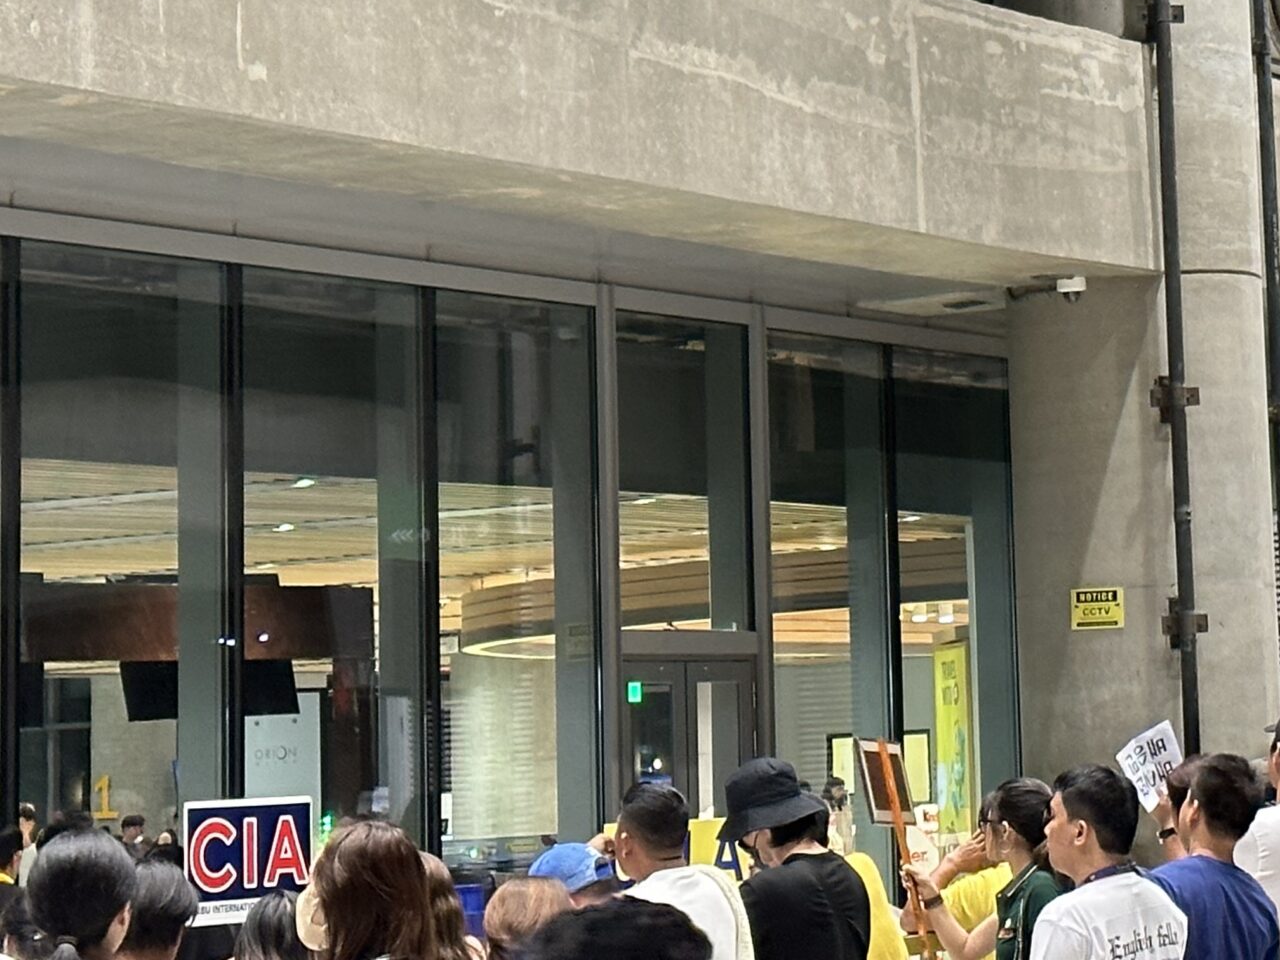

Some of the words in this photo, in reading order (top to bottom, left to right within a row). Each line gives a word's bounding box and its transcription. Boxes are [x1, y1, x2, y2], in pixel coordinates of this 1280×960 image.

[1079, 591, 1114, 602] NOTICE
[1082, 606, 1111, 617] CCTV
[91, 774, 120, 819] 1
[190, 815, 309, 893] CIA
